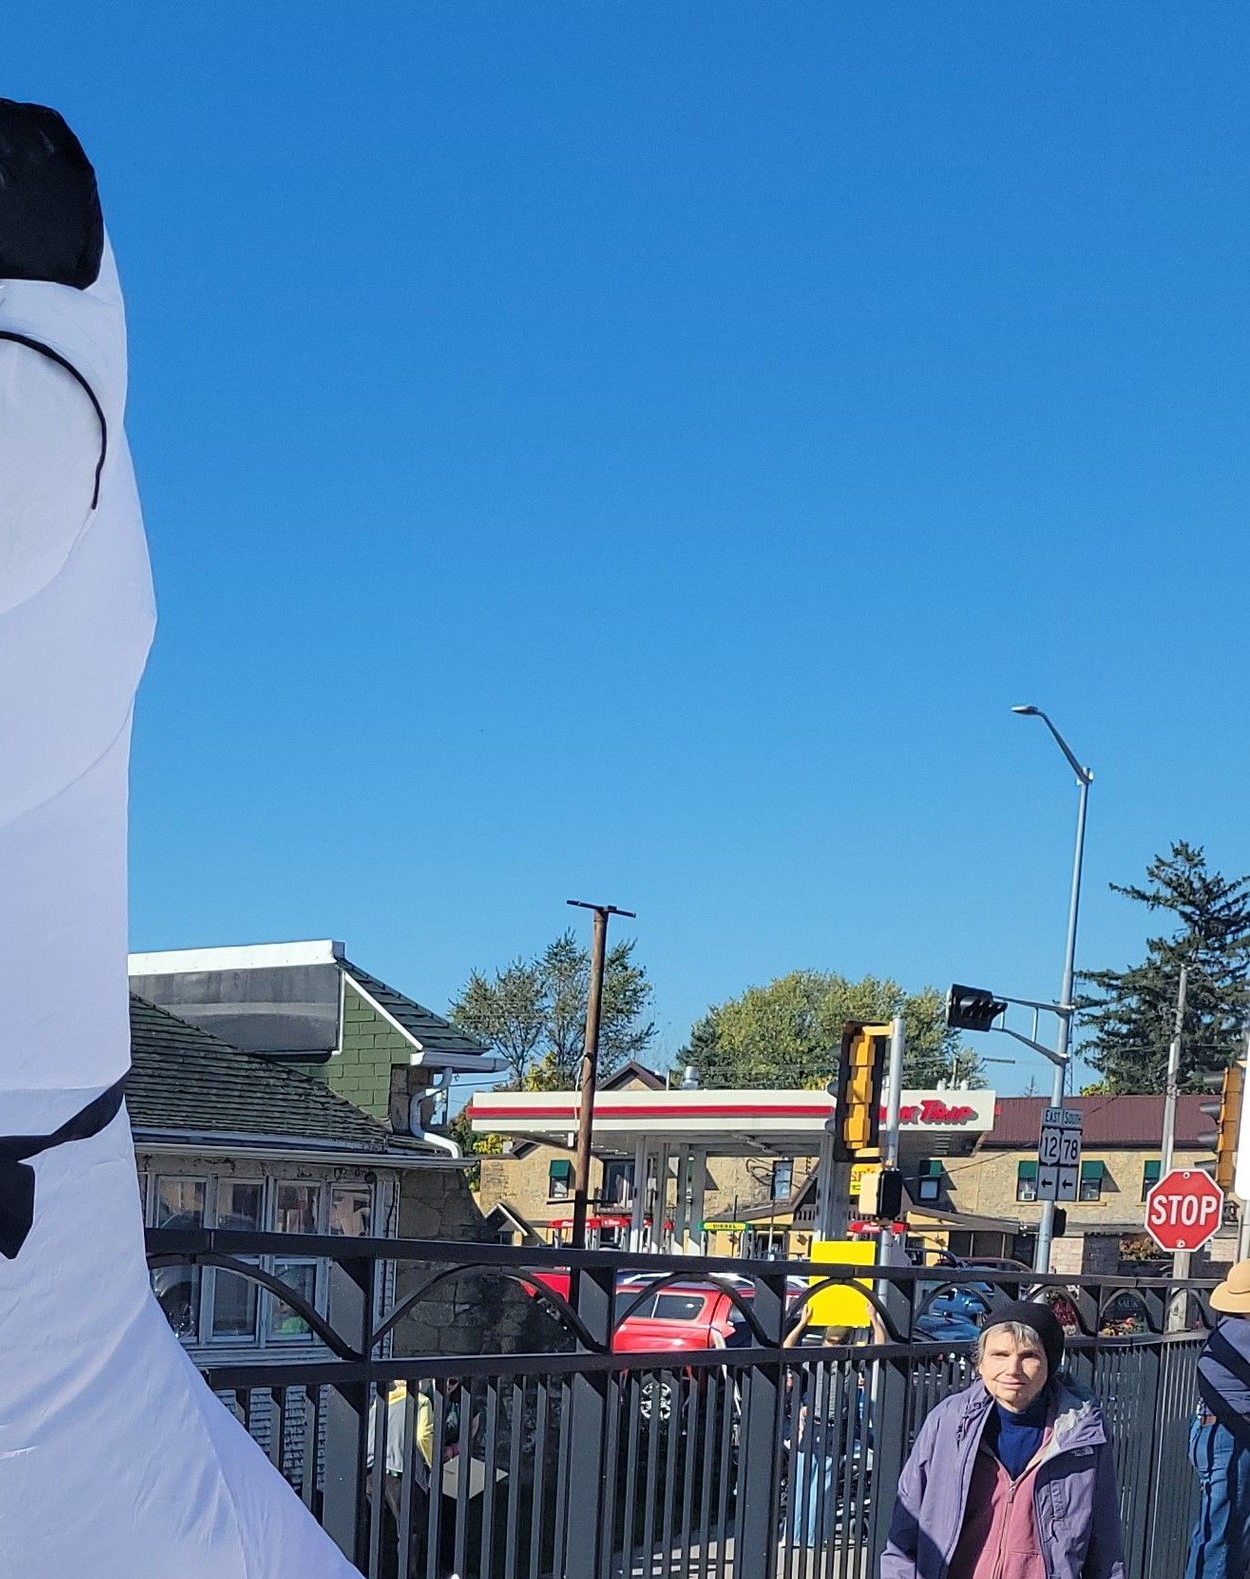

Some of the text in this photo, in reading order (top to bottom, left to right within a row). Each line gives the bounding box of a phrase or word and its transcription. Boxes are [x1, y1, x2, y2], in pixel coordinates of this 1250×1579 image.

[1045, 1109, 1061, 1123] EAST
[1044, 1136, 1057, 1158] 12
[1063, 1138, 1079, 1161] 78
[1150, 1194, 1218, 1226] STOP
